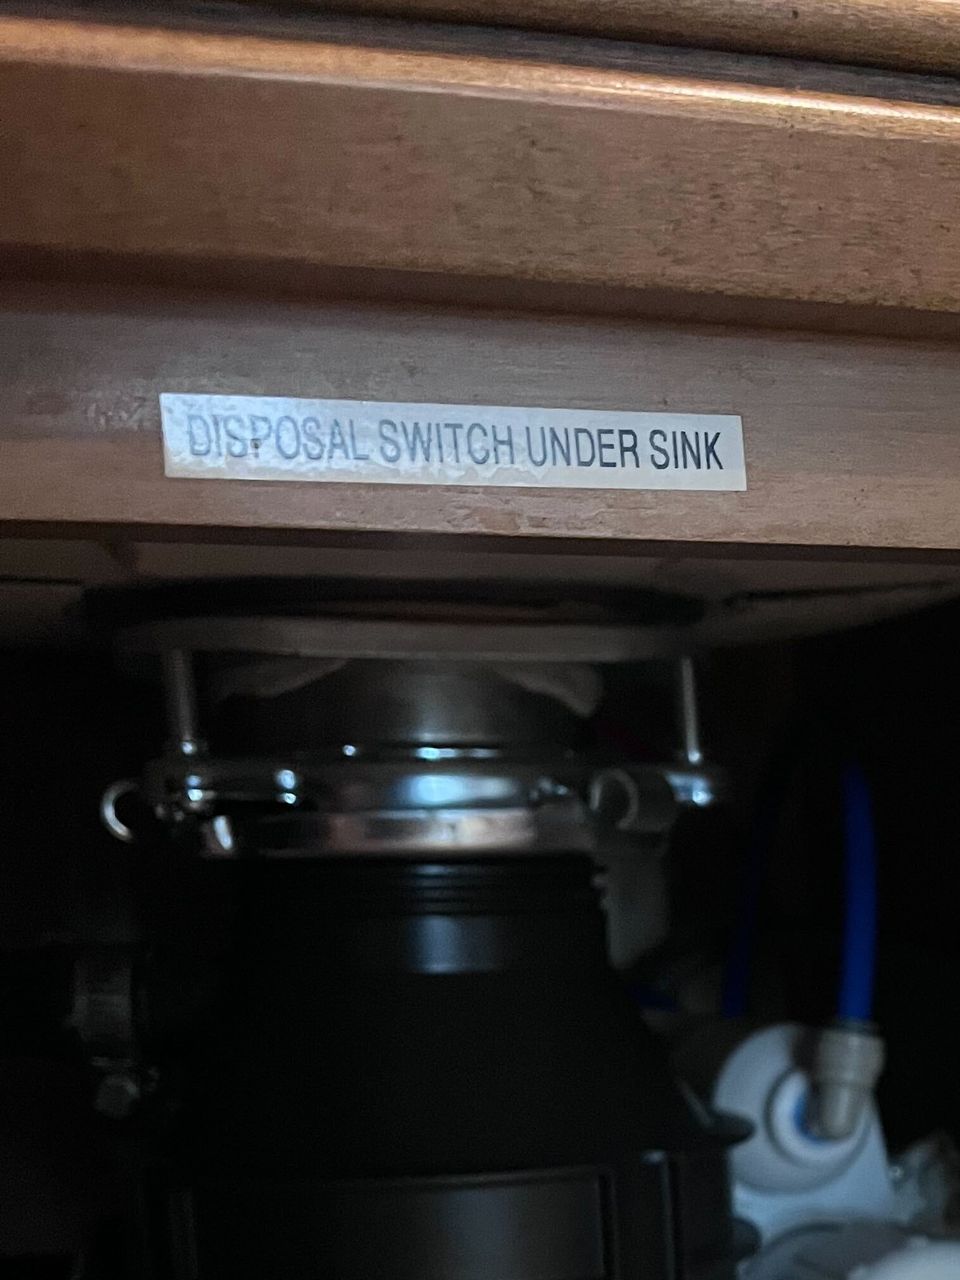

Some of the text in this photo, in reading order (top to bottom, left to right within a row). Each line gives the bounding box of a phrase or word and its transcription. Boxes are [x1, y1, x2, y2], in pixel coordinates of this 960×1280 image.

[188, 414, 725, 470] DISPOSAL SWITCH UNDER SINK
